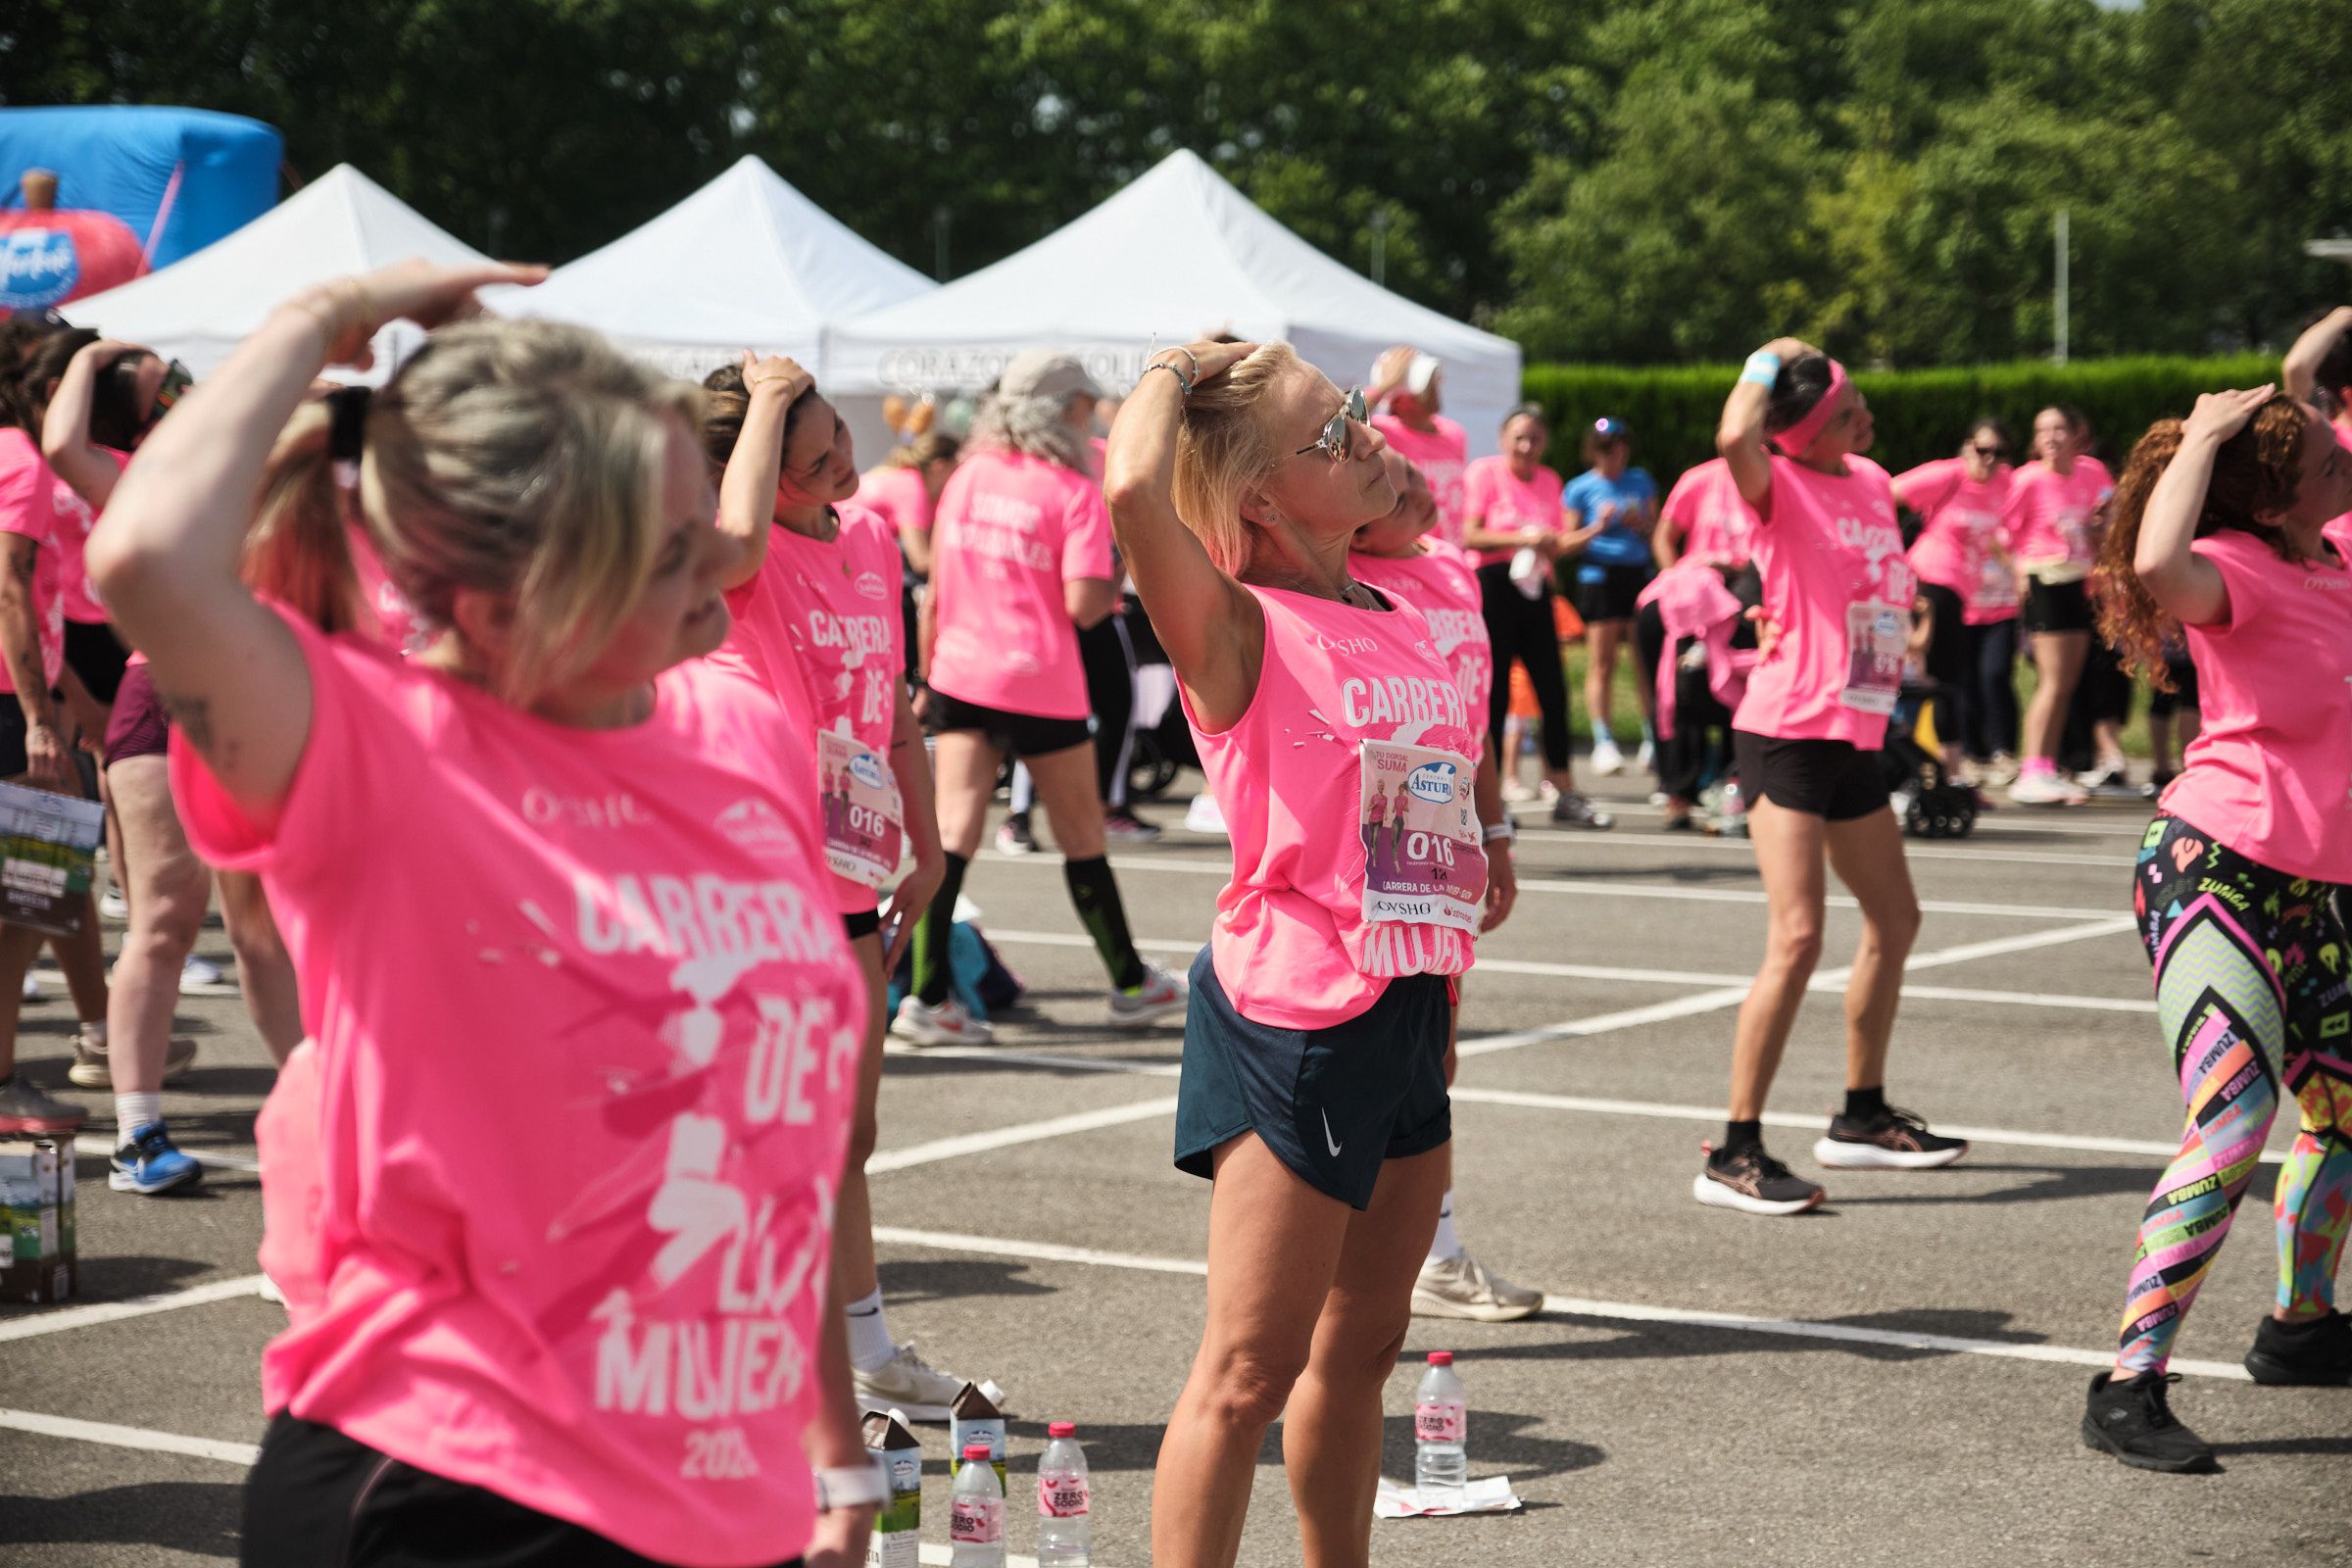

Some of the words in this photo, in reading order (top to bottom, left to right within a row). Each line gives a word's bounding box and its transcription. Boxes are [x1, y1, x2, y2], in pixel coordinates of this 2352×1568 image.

[1377, 759, 1407, 773] SUMA
[850, 806, 885, 838] 016
[1406, 832, 1455, 867] 016
[1420, 883, 1431, 893] DE
[2197, 877, 2251, 911] ZUMBA
[1378, 901, 1431, 915] OYSHO
[2199, 1032, 2236, 1075] ZUMBA
[2219, 1060, 2262, 1102] ZUMBA
[2167, 1175, 2218, 1206] ZUMBA
[2134, 1303, 2177, 1334] ZUMBA
[1054, 1491, 1083, 1501] ZERO
[1054, 1498, 1084, 1508] SODIO
